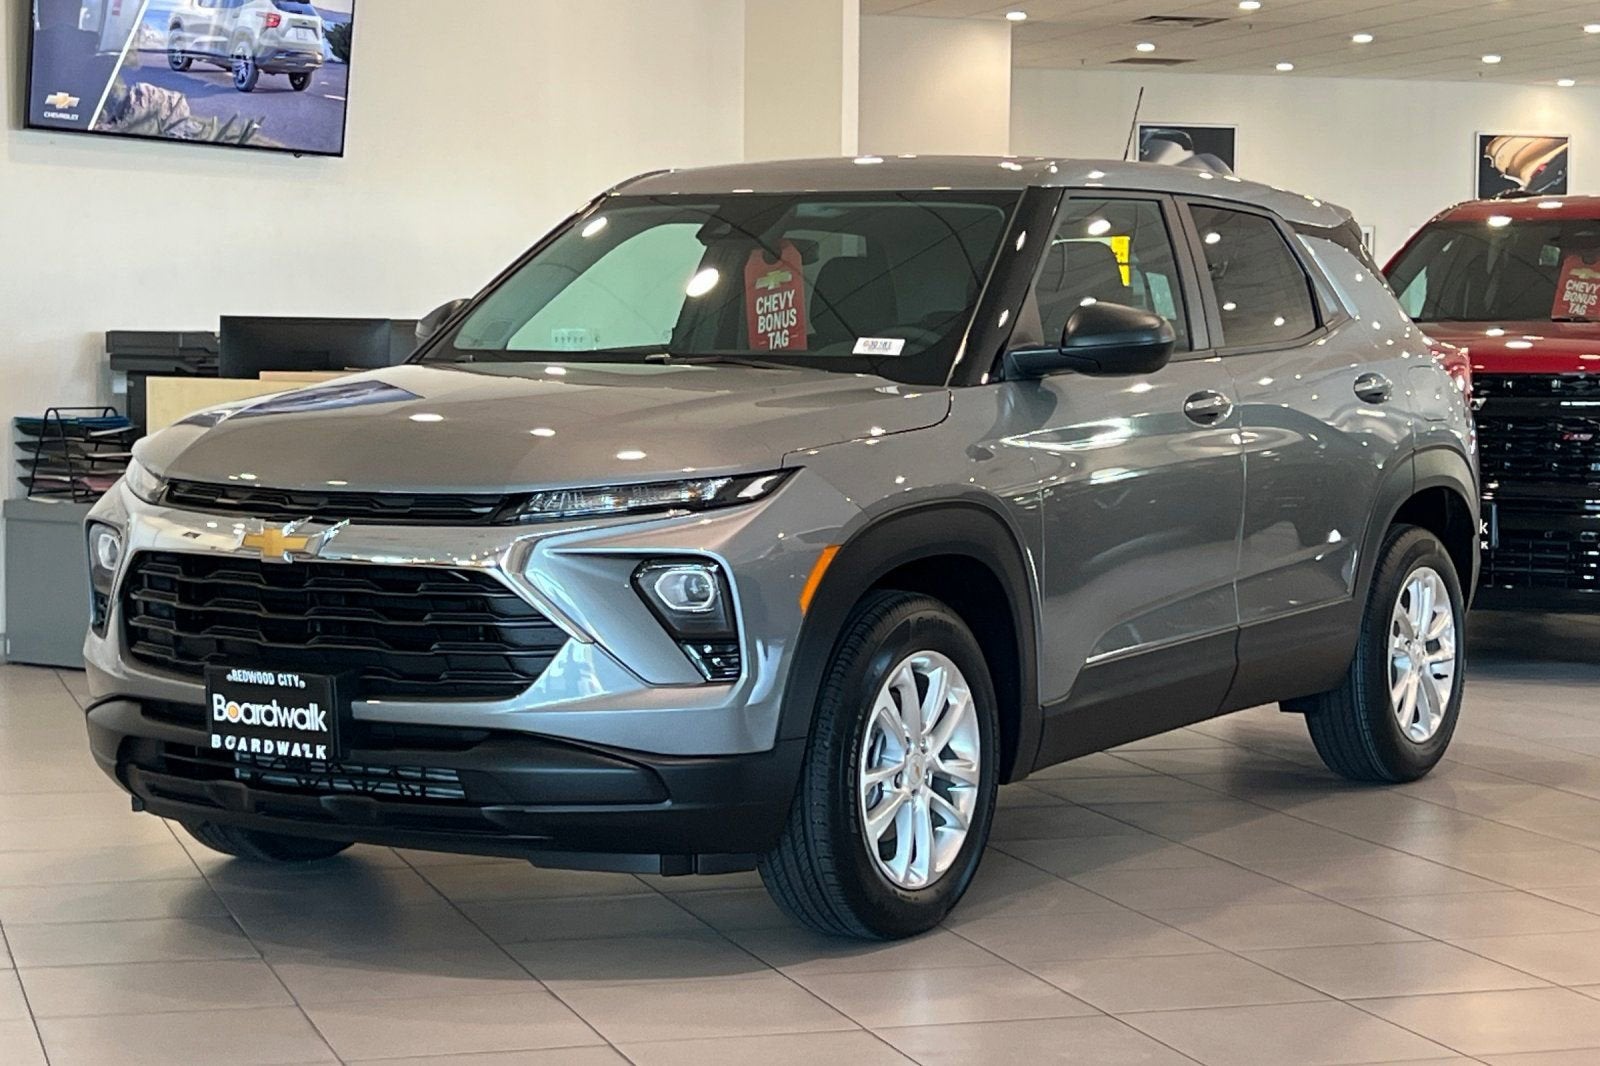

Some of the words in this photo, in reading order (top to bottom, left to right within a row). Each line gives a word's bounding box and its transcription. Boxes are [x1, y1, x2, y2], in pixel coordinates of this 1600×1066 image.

[1566, 280, 1600, 294] CHEVY
[756, 290, 795, 314] CHEVY
[1563, 291, 1598, 306] BONUS
[1568, 303, 1587, 315] TAG
[758, 308, 797, 333] BONUS
[767, 331, 790, 350] TAG
[230, 669, 275, 685] REDWOOD
[277, 673, 299, 688] CITY
[212, 693, 328, 732] Boardwalk
[211, 734, 327, 760] BOARDWALK
